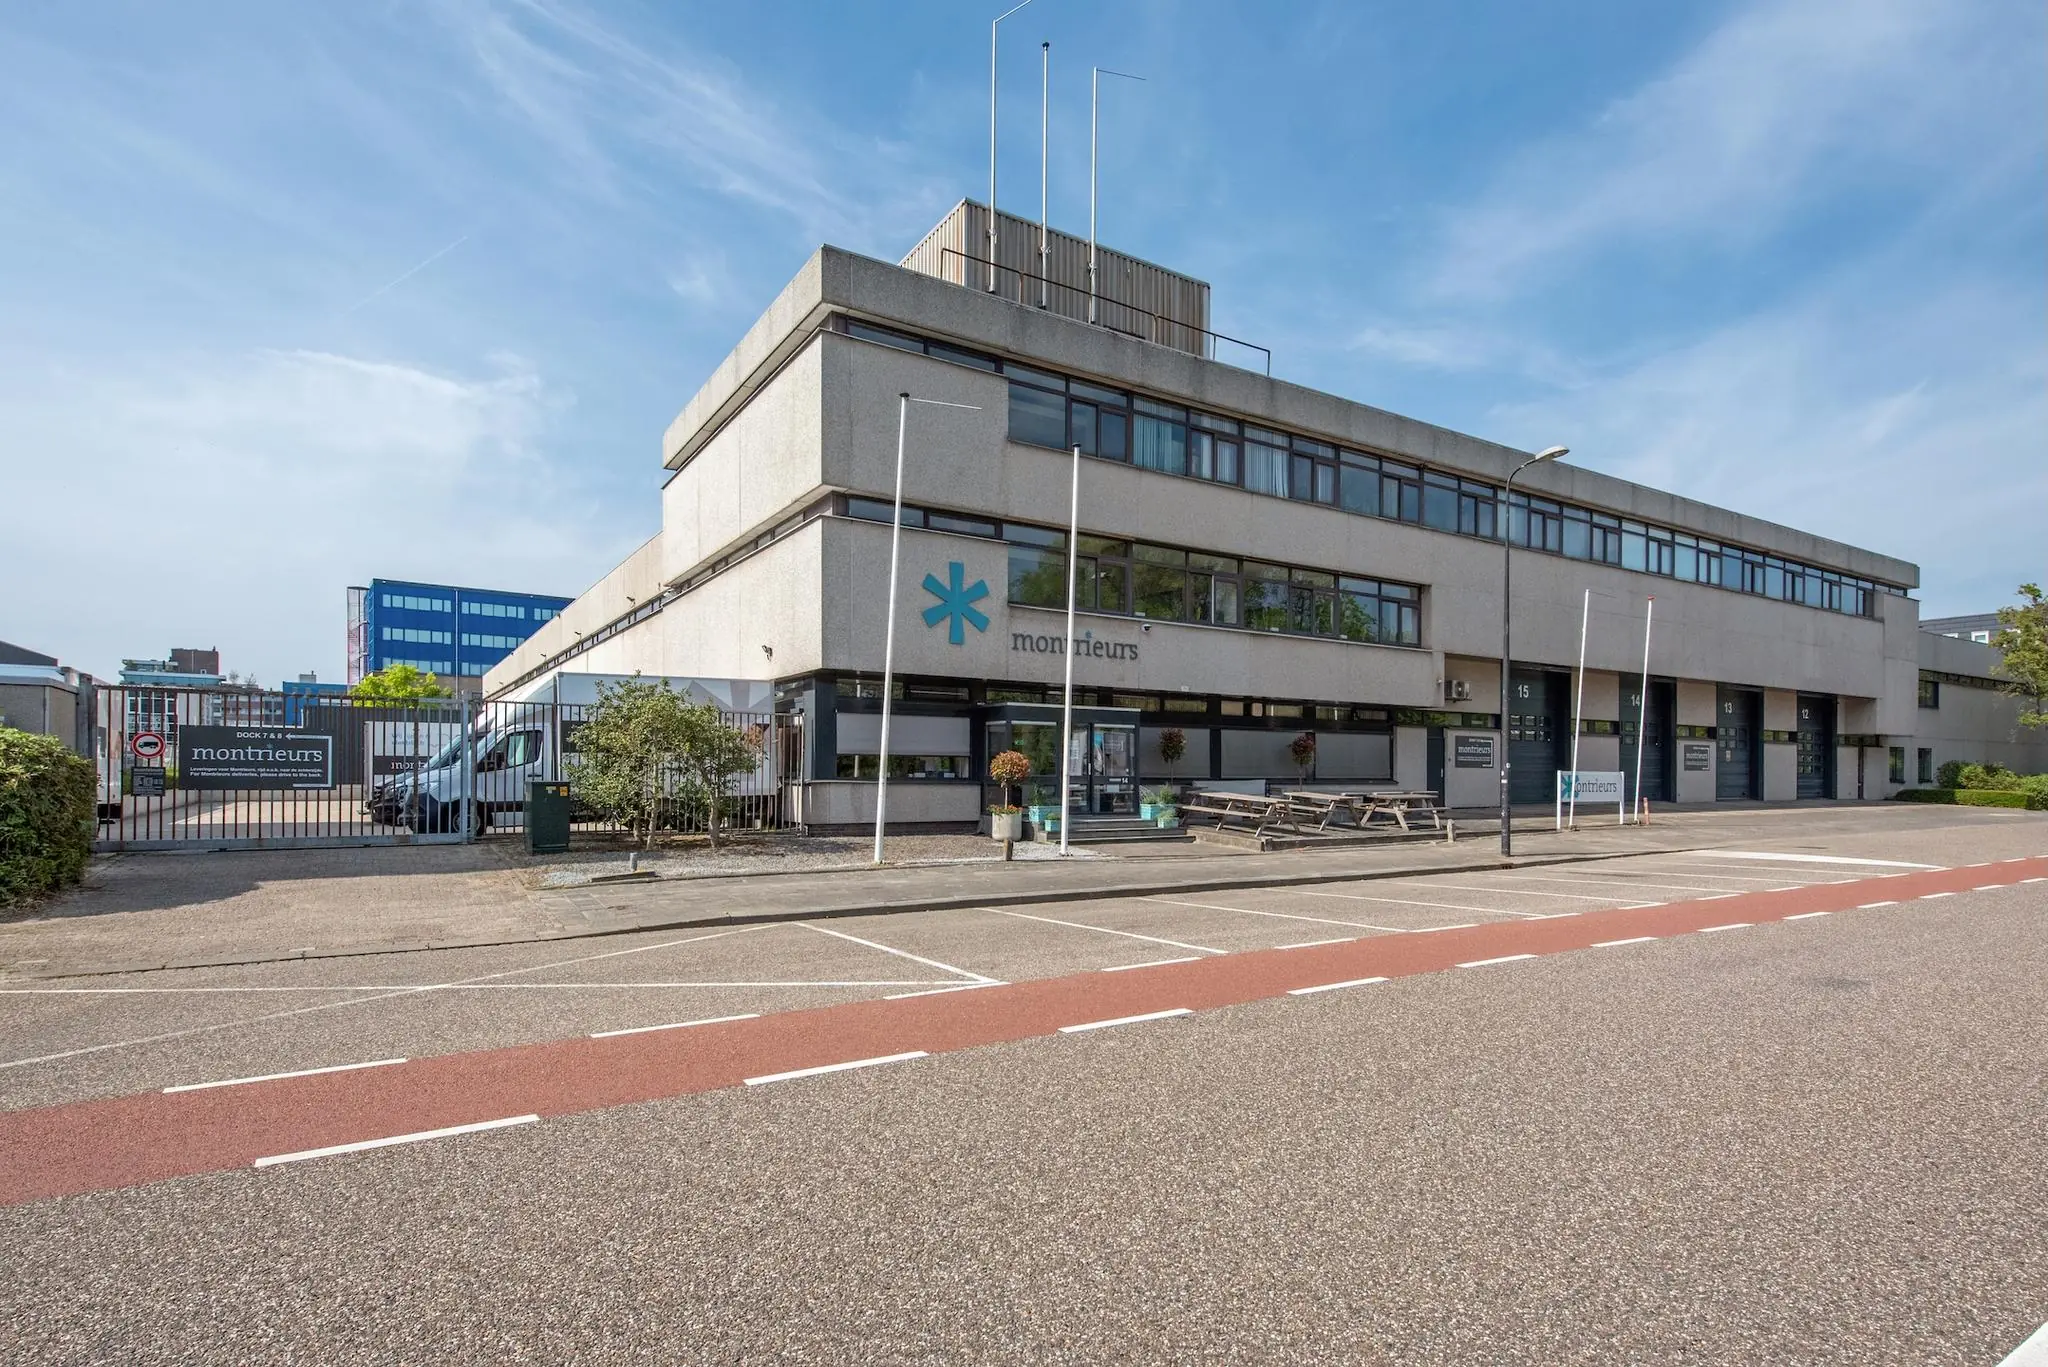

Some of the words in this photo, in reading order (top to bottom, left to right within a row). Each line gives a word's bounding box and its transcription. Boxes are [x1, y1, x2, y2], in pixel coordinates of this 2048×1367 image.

[1518, 684, 1529, 698] 15
[1631, 694, 1640, 707] 14
[1724, 702, 1733, 714] 13
[1801, 708, 1809, 719] 12
[236, 731, 261, 739] DOCK
[191, 743, 323, 762] montrieurs
